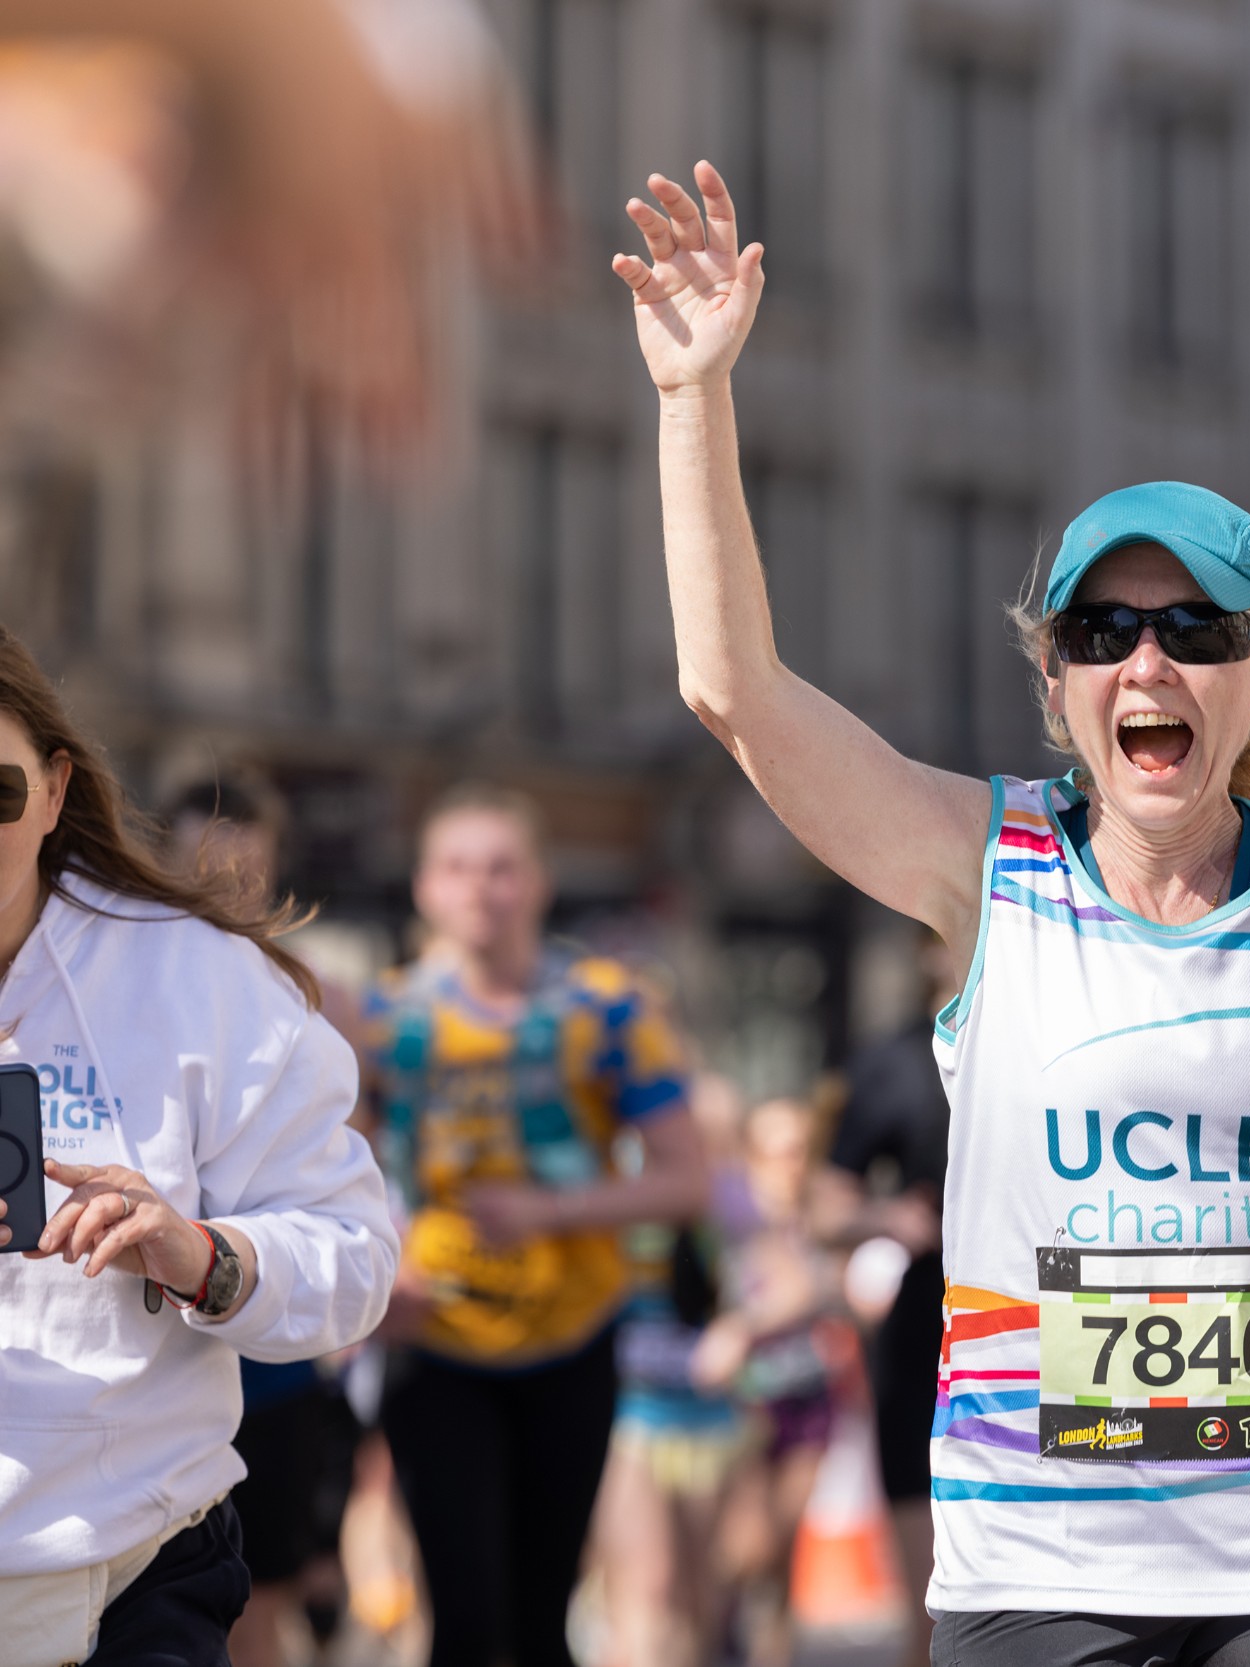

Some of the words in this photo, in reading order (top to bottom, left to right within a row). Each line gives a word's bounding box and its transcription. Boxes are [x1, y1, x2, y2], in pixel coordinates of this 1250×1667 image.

[53, 1044, 79, 1058] THE
[37, 1063, 96, 1096] OLI
[43, 1136, 85, 1149] RUST
[1059, 1427, 1096, 1445] LONDON
[1106, 1431, 1143, 1445] LANDMARKS
